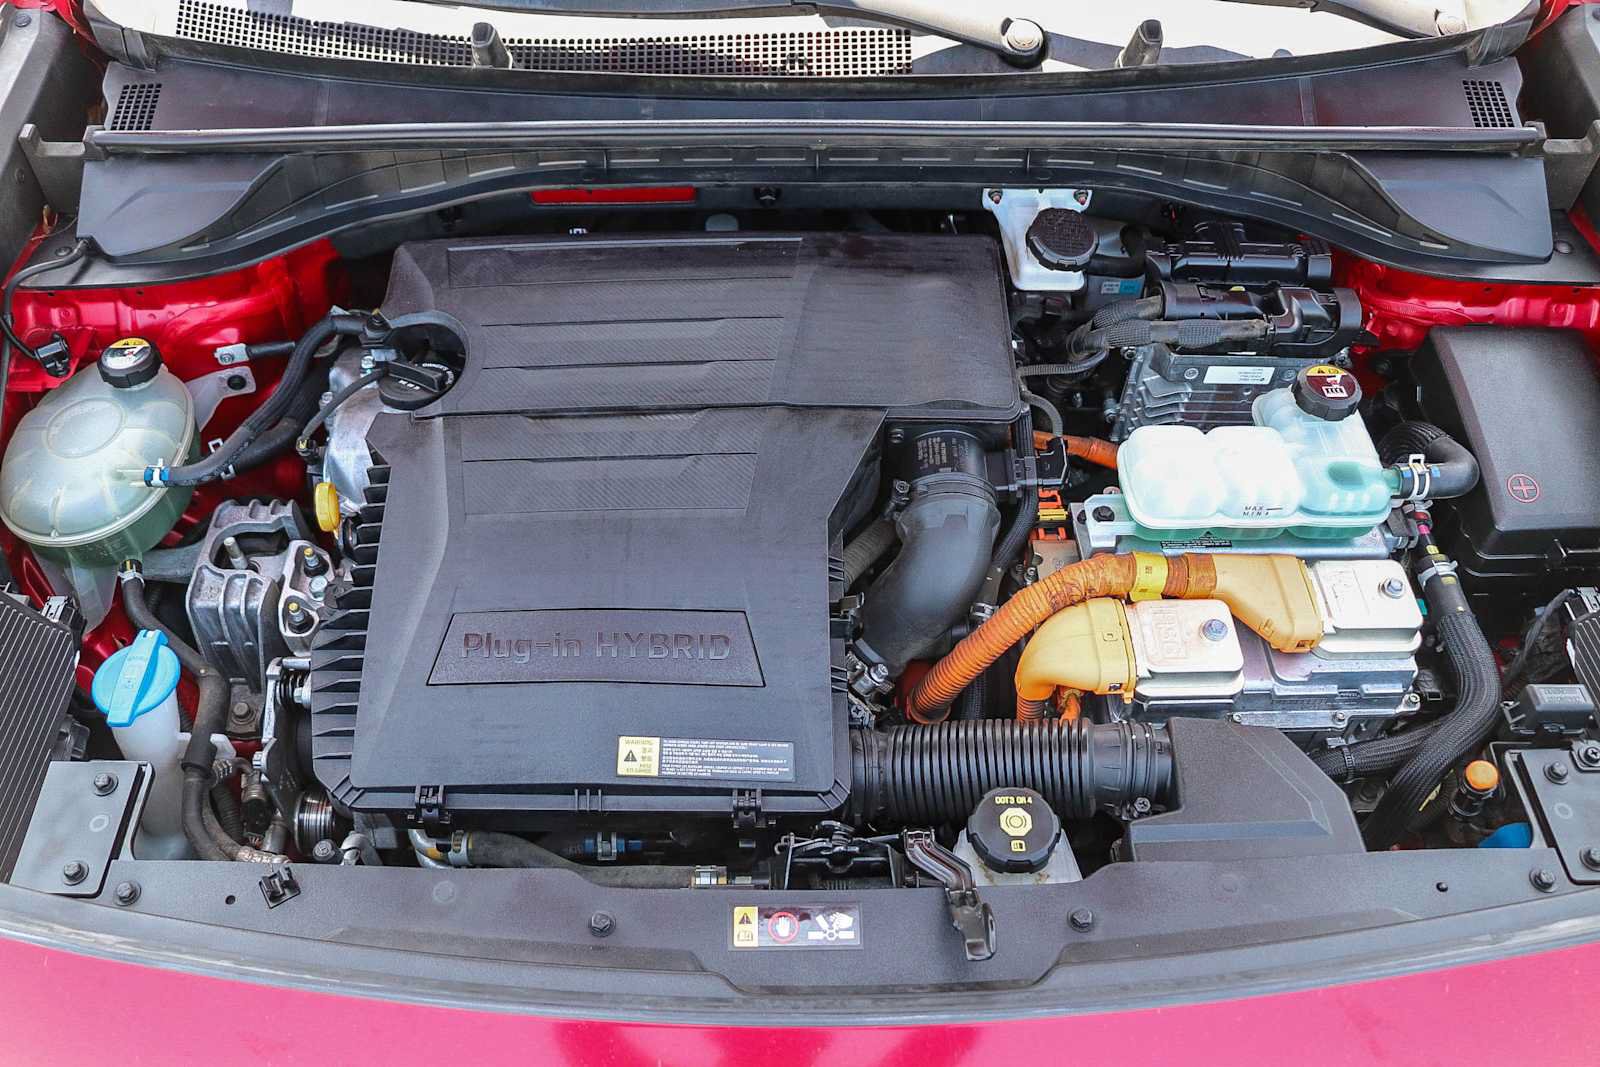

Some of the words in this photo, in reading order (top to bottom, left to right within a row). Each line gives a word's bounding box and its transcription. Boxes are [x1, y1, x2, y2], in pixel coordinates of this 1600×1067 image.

[462, 632, 582, 663] Plug-in
[595, 631, 732, 660] HYBRID
[994, 796, 1015, 804] DOT3
[1016, 796, 1027, 804] OR
[1027, 796, 1033, 804] 4
